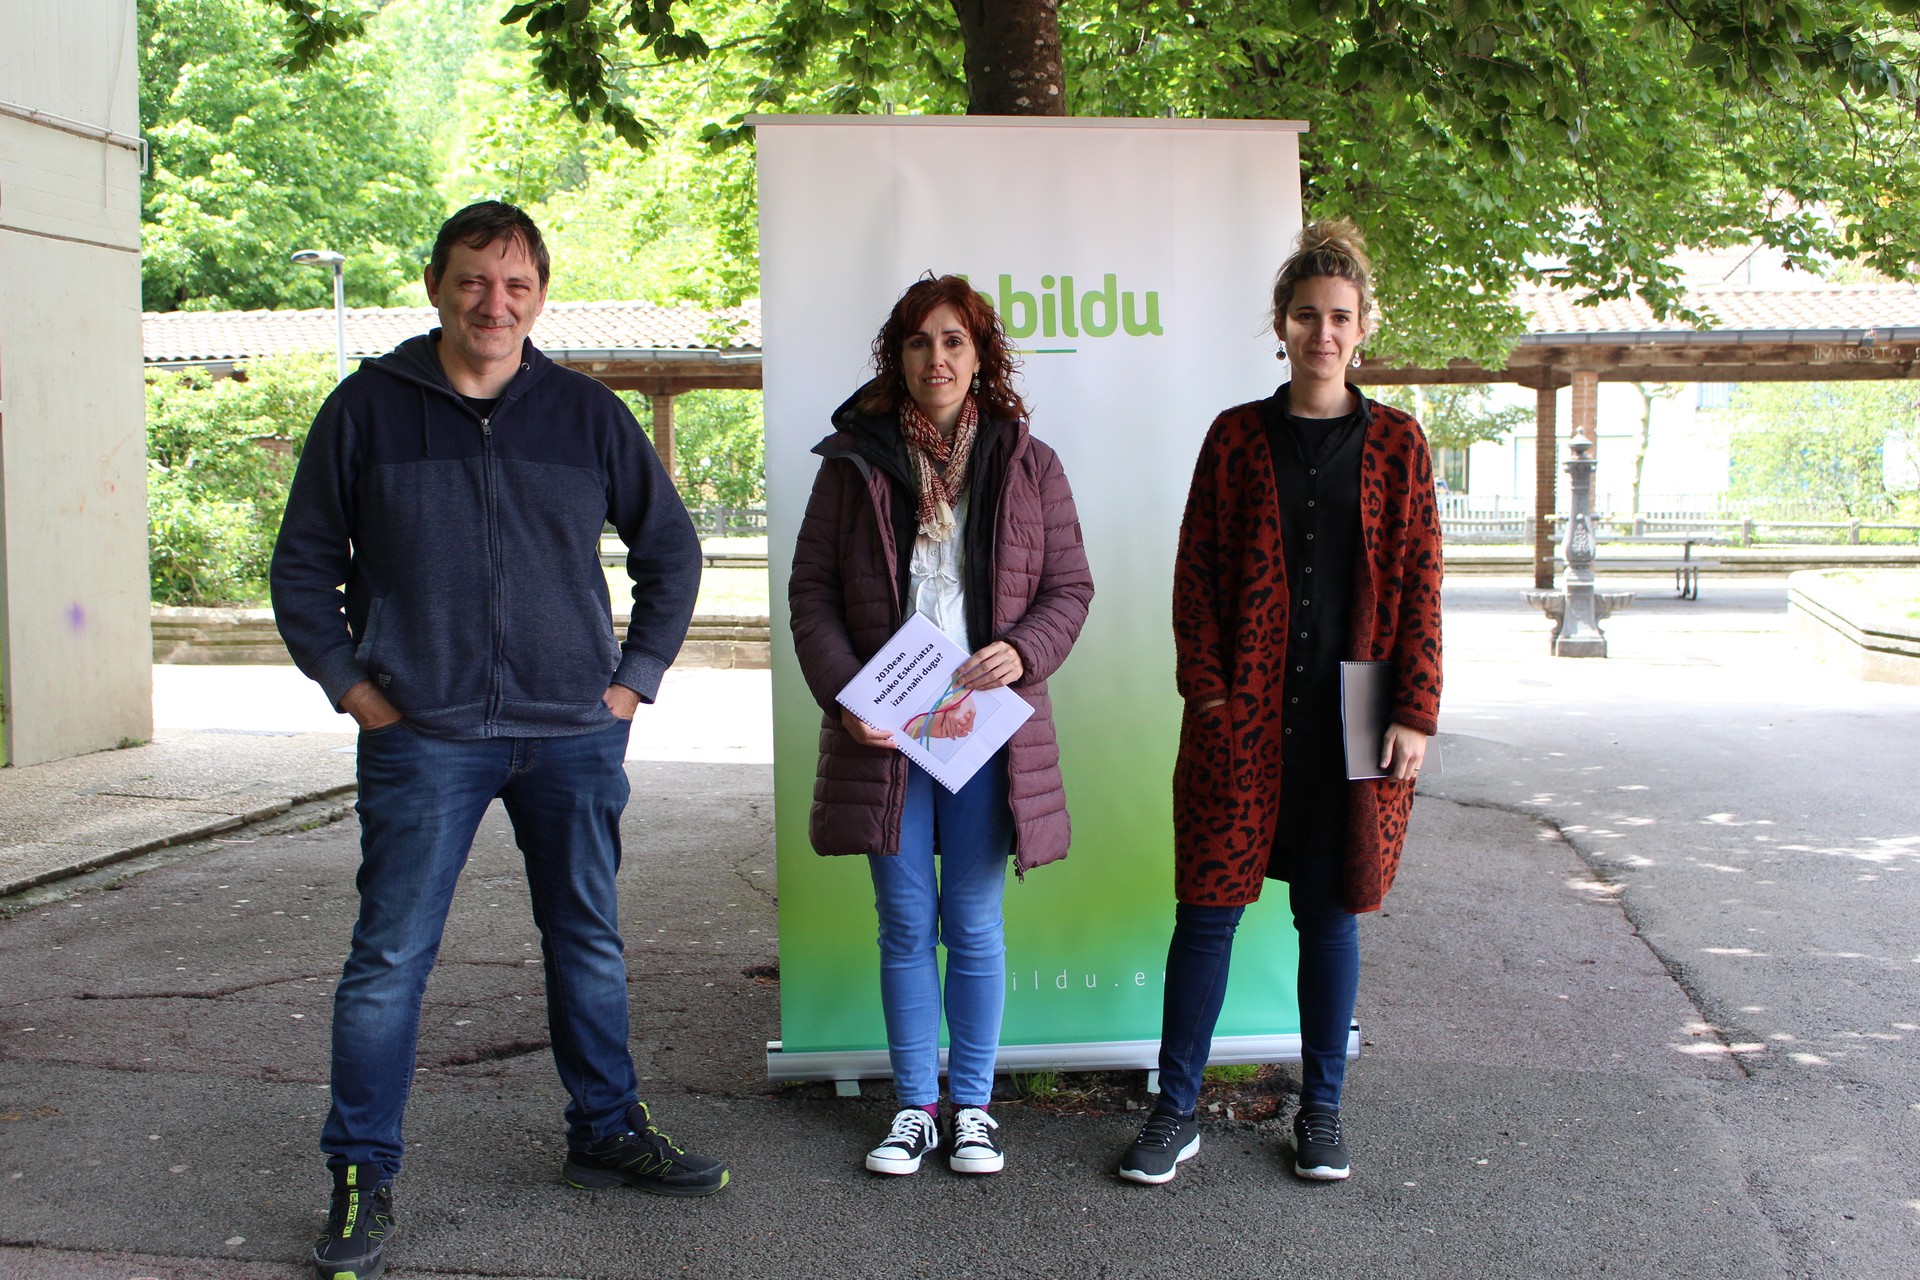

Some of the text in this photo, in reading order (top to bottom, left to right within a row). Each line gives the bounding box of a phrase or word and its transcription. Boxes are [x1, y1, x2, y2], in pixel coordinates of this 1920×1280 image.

[956, 273, 1164, 338] bildu
[873, 643, 935, 705] Nolako Eskoriatza
[875, 652, 906, 682] 2030ean
[890, 652, 943, 707] izan nahi dugu?
